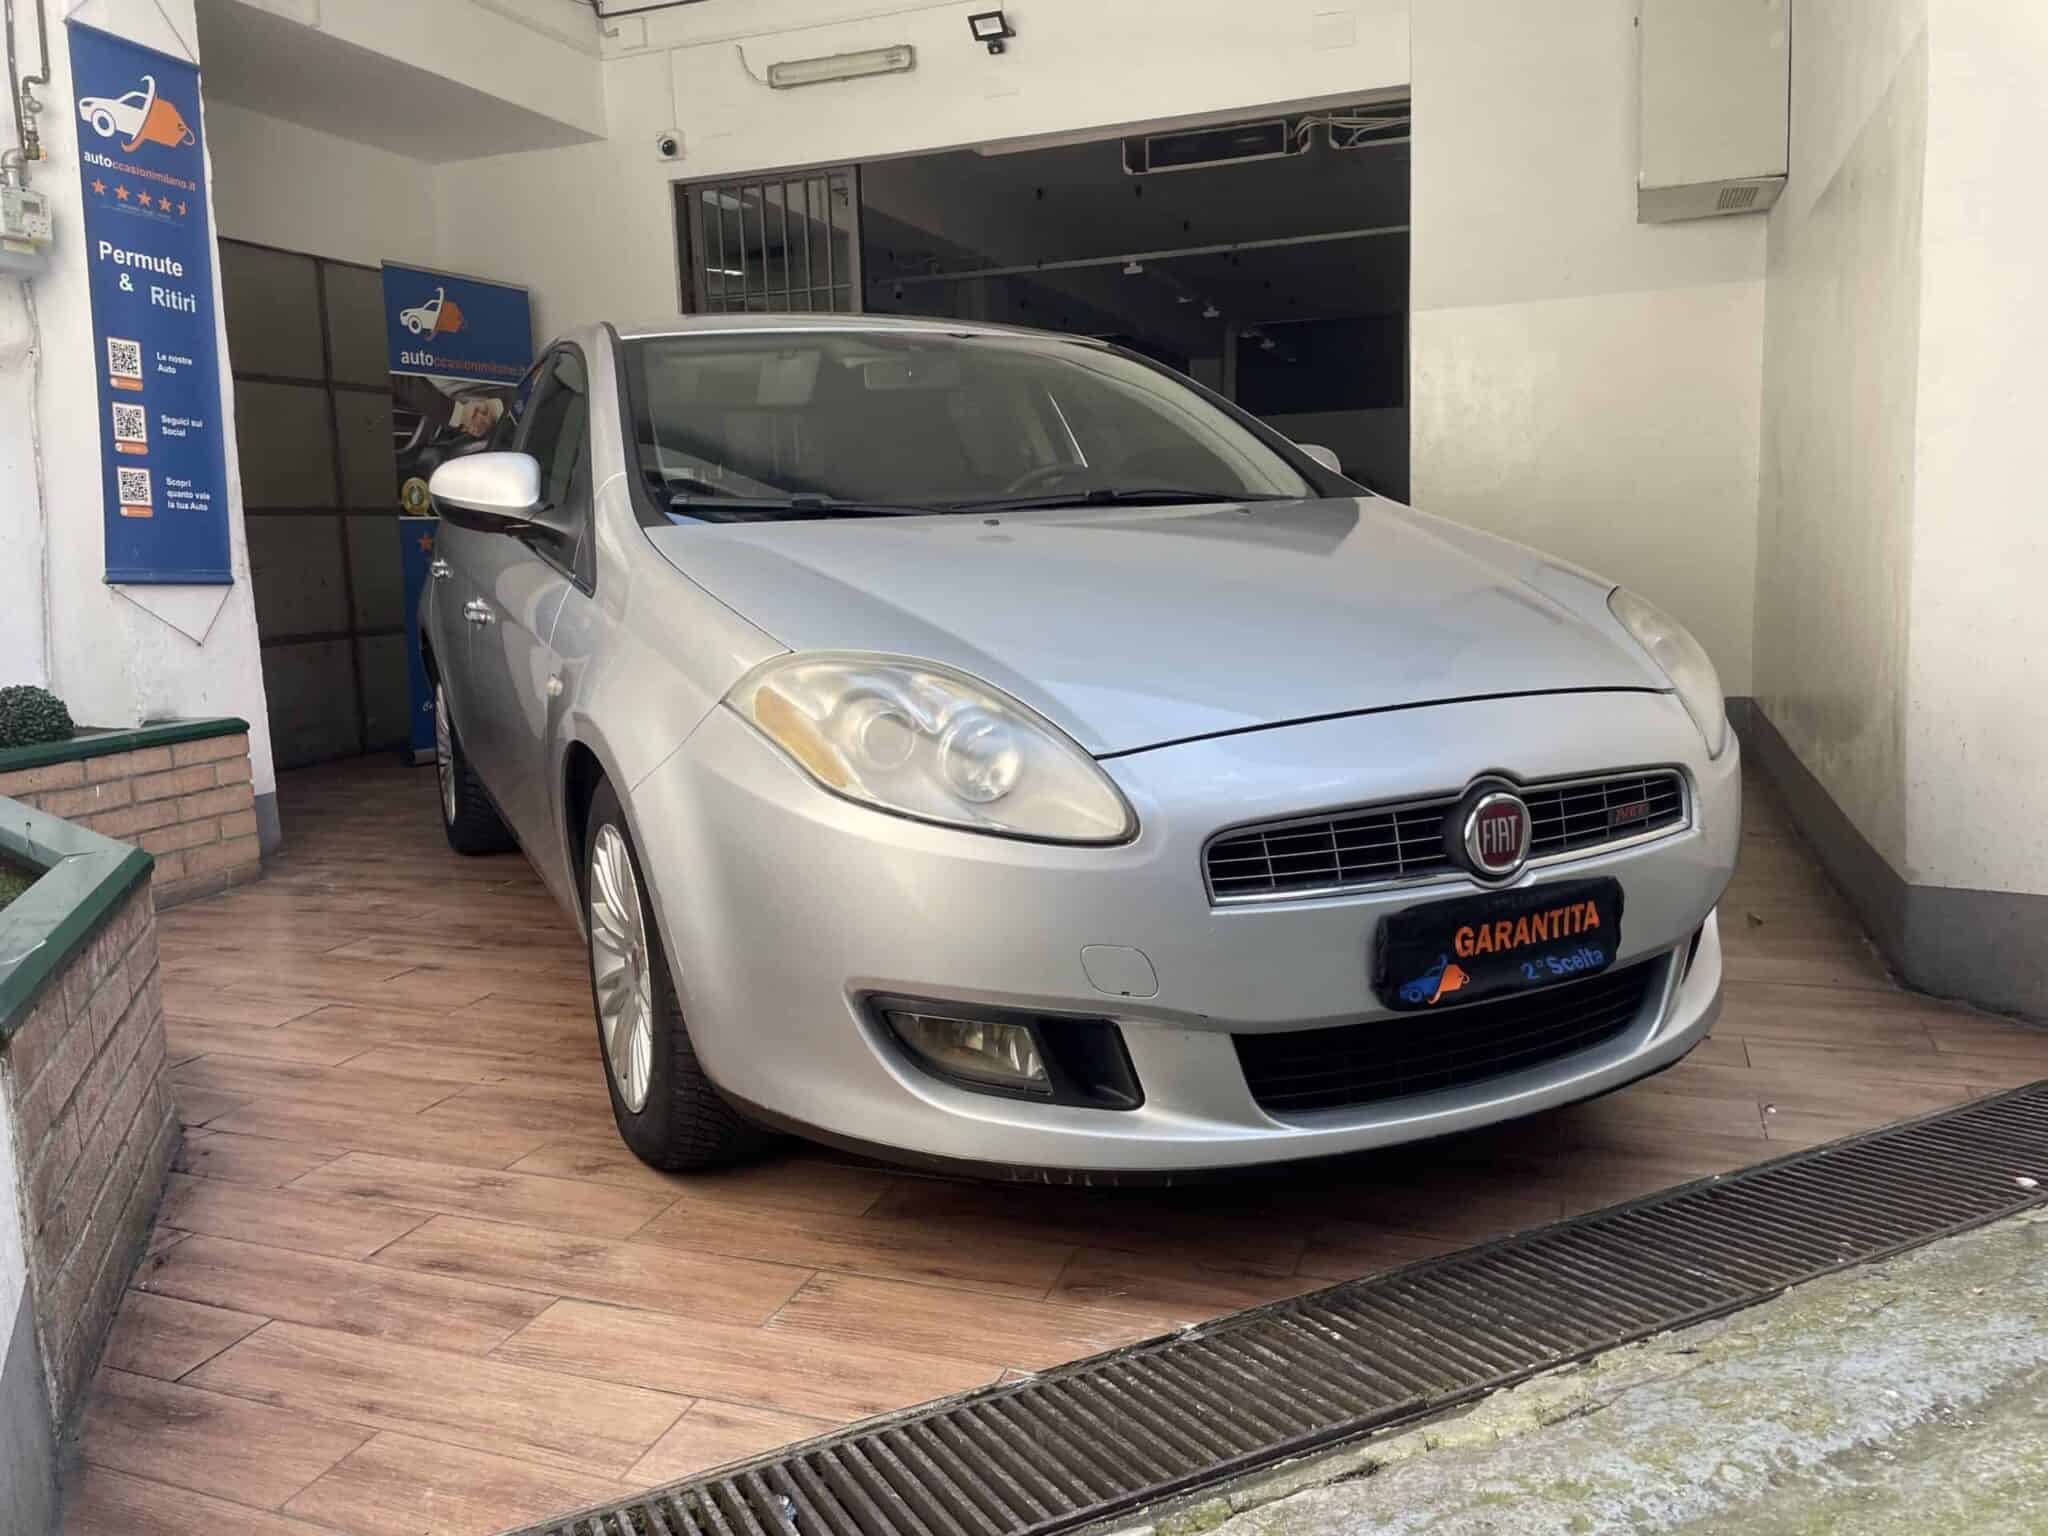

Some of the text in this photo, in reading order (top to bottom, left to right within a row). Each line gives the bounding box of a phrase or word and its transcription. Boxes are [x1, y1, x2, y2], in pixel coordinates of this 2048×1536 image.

[98, 239, 183, 277] Permute
[119, 272, 196, 313] & Ritiri
[157, 363, 177, 375] Auto
[165, 476, 192, 488] Scopri
[166, 490, 194, 500] quanto
[167, 500, 209, 512] la tua Auto
[1481, 815, 1519, 855] FIAT
[1454, 900, 1600, 957] GARANTITA
[1547, 947, 1604, 975] Scelta
